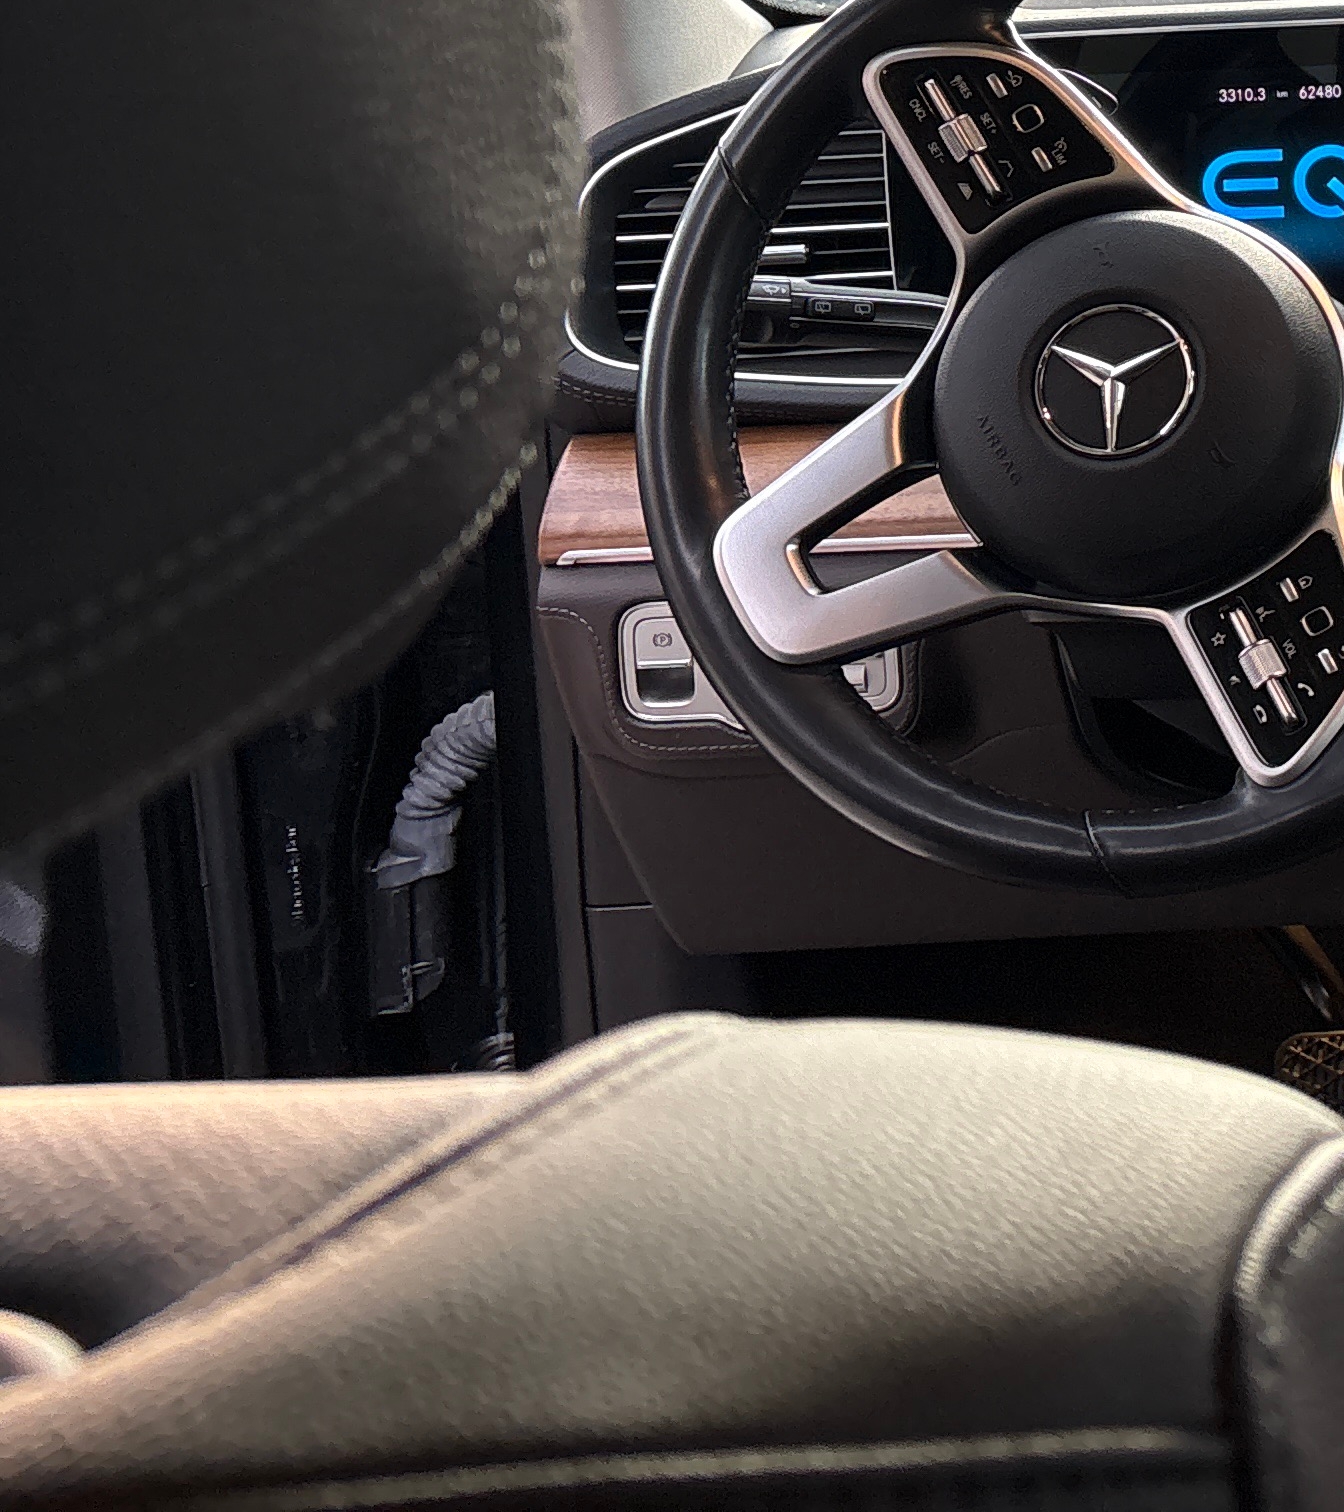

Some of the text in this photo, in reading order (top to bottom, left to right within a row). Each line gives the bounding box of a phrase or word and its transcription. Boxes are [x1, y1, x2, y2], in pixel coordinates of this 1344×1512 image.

[958, 81, 973, 100] RES
[1218, 87, 1266, 103] 3310.3
[1299, 84, 1342, 100] 62480
[908, 98, 927, 123] CNCL
[1051, 148, 1067, 165] LIM
[1282, 638, 1297, 659] VOL
